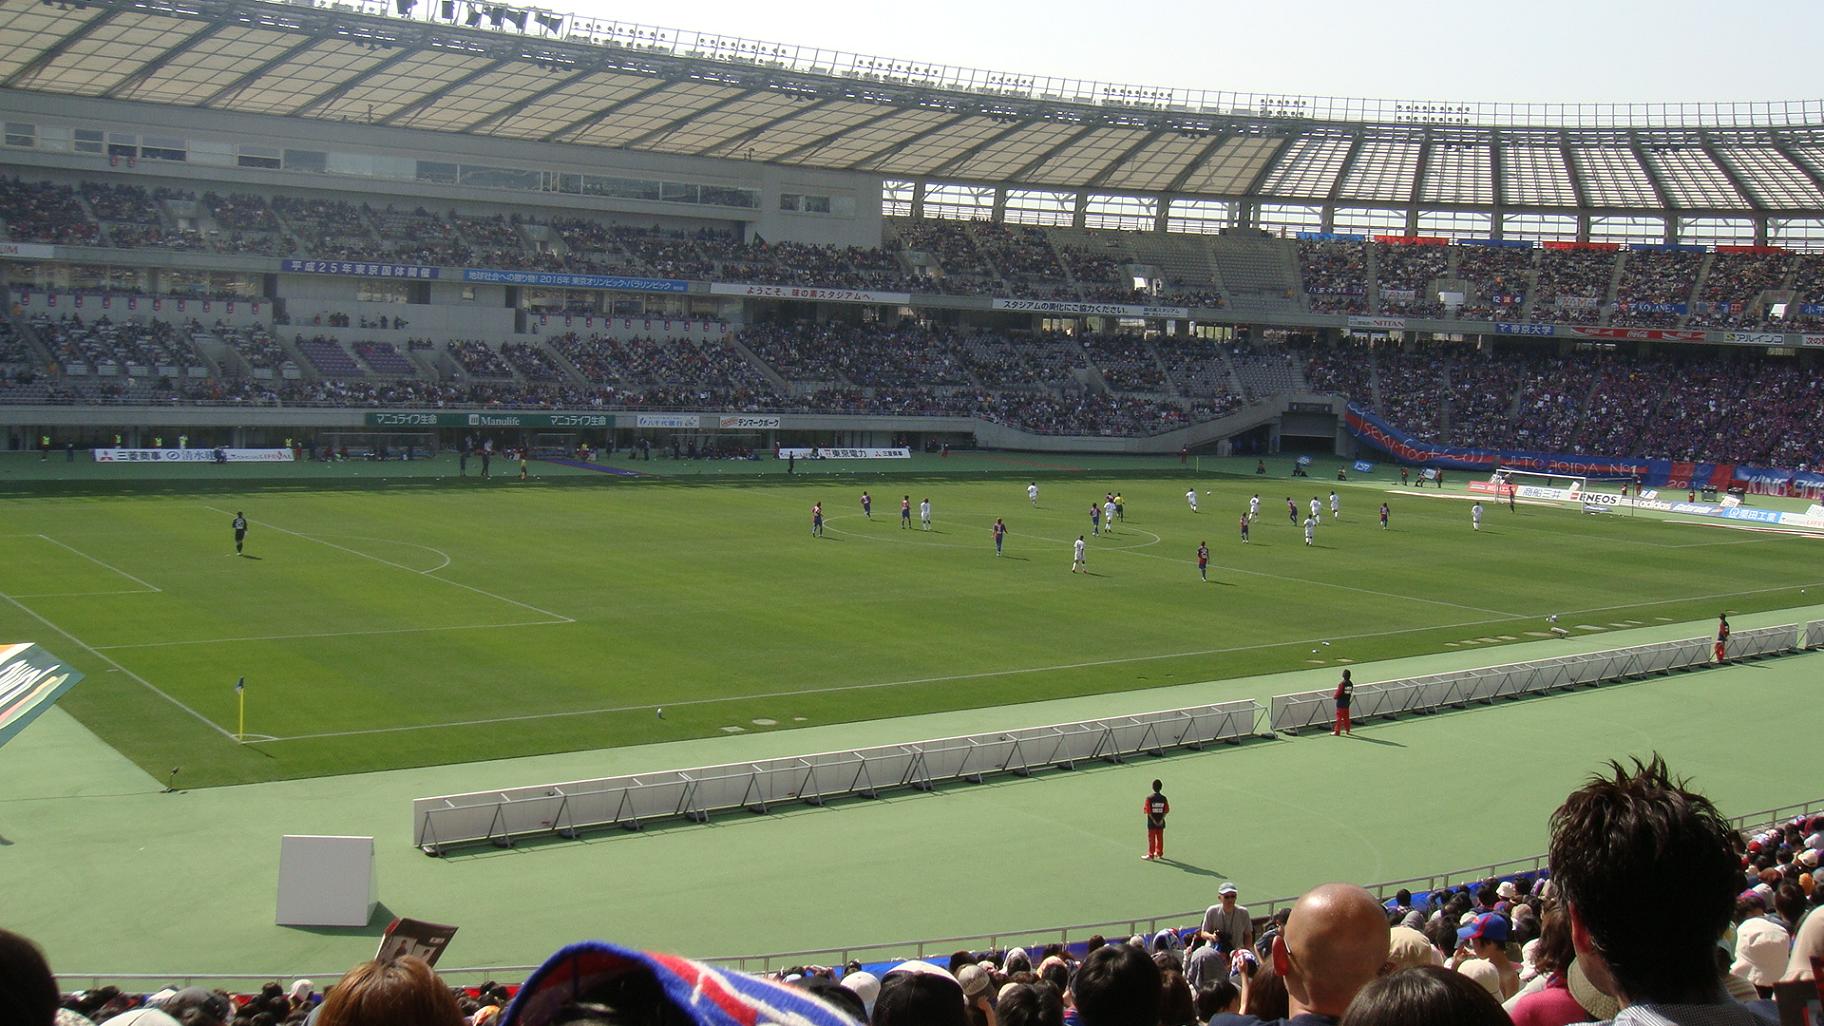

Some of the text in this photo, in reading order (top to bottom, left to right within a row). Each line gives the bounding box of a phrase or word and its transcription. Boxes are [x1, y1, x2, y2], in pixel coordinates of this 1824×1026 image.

[291, 260, 431, 278] 平成25年東京国体開催
[1735, 333, 1783, 344] アルインコ
[376, 413, 438, 425] マニュライフ生命
[481, 415, 521, 427] Manulife
[550, 414, 607, 426] マニュライフ生命
[1579, 493, 1617, 504] ENEOS
